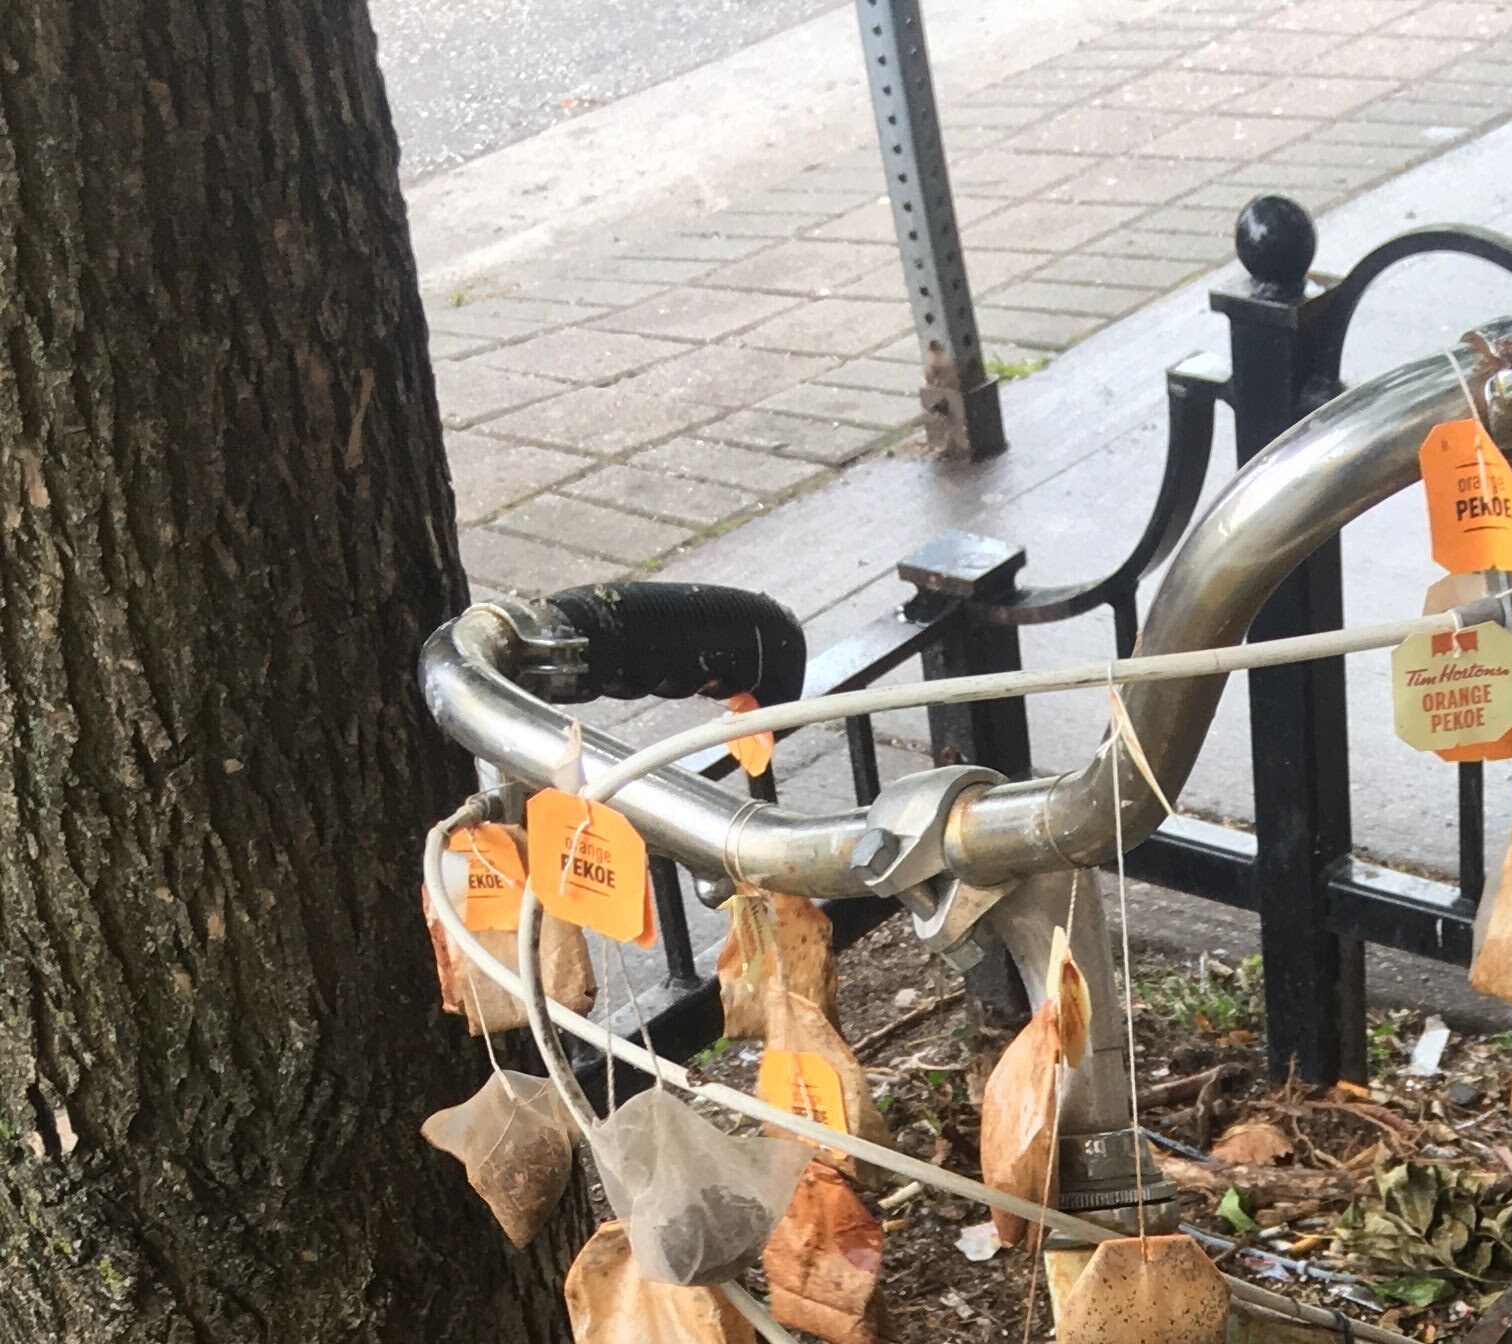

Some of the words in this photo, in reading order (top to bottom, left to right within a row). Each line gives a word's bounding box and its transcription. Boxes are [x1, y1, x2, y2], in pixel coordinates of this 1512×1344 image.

[1457, 474, 1505, 496] orage
[1455, 496, 1512, 522] PEKOE
[1405, 668, 1437, 687] Tim
[1438, 663, 1510, 684] Hortons
[1422, 683, 1493, 713] ORANGE
[1430, 706, 1486, 734] PEKOE
[564, 836, 612, 865] oange
[467, 873, 505, 889] EKOE
